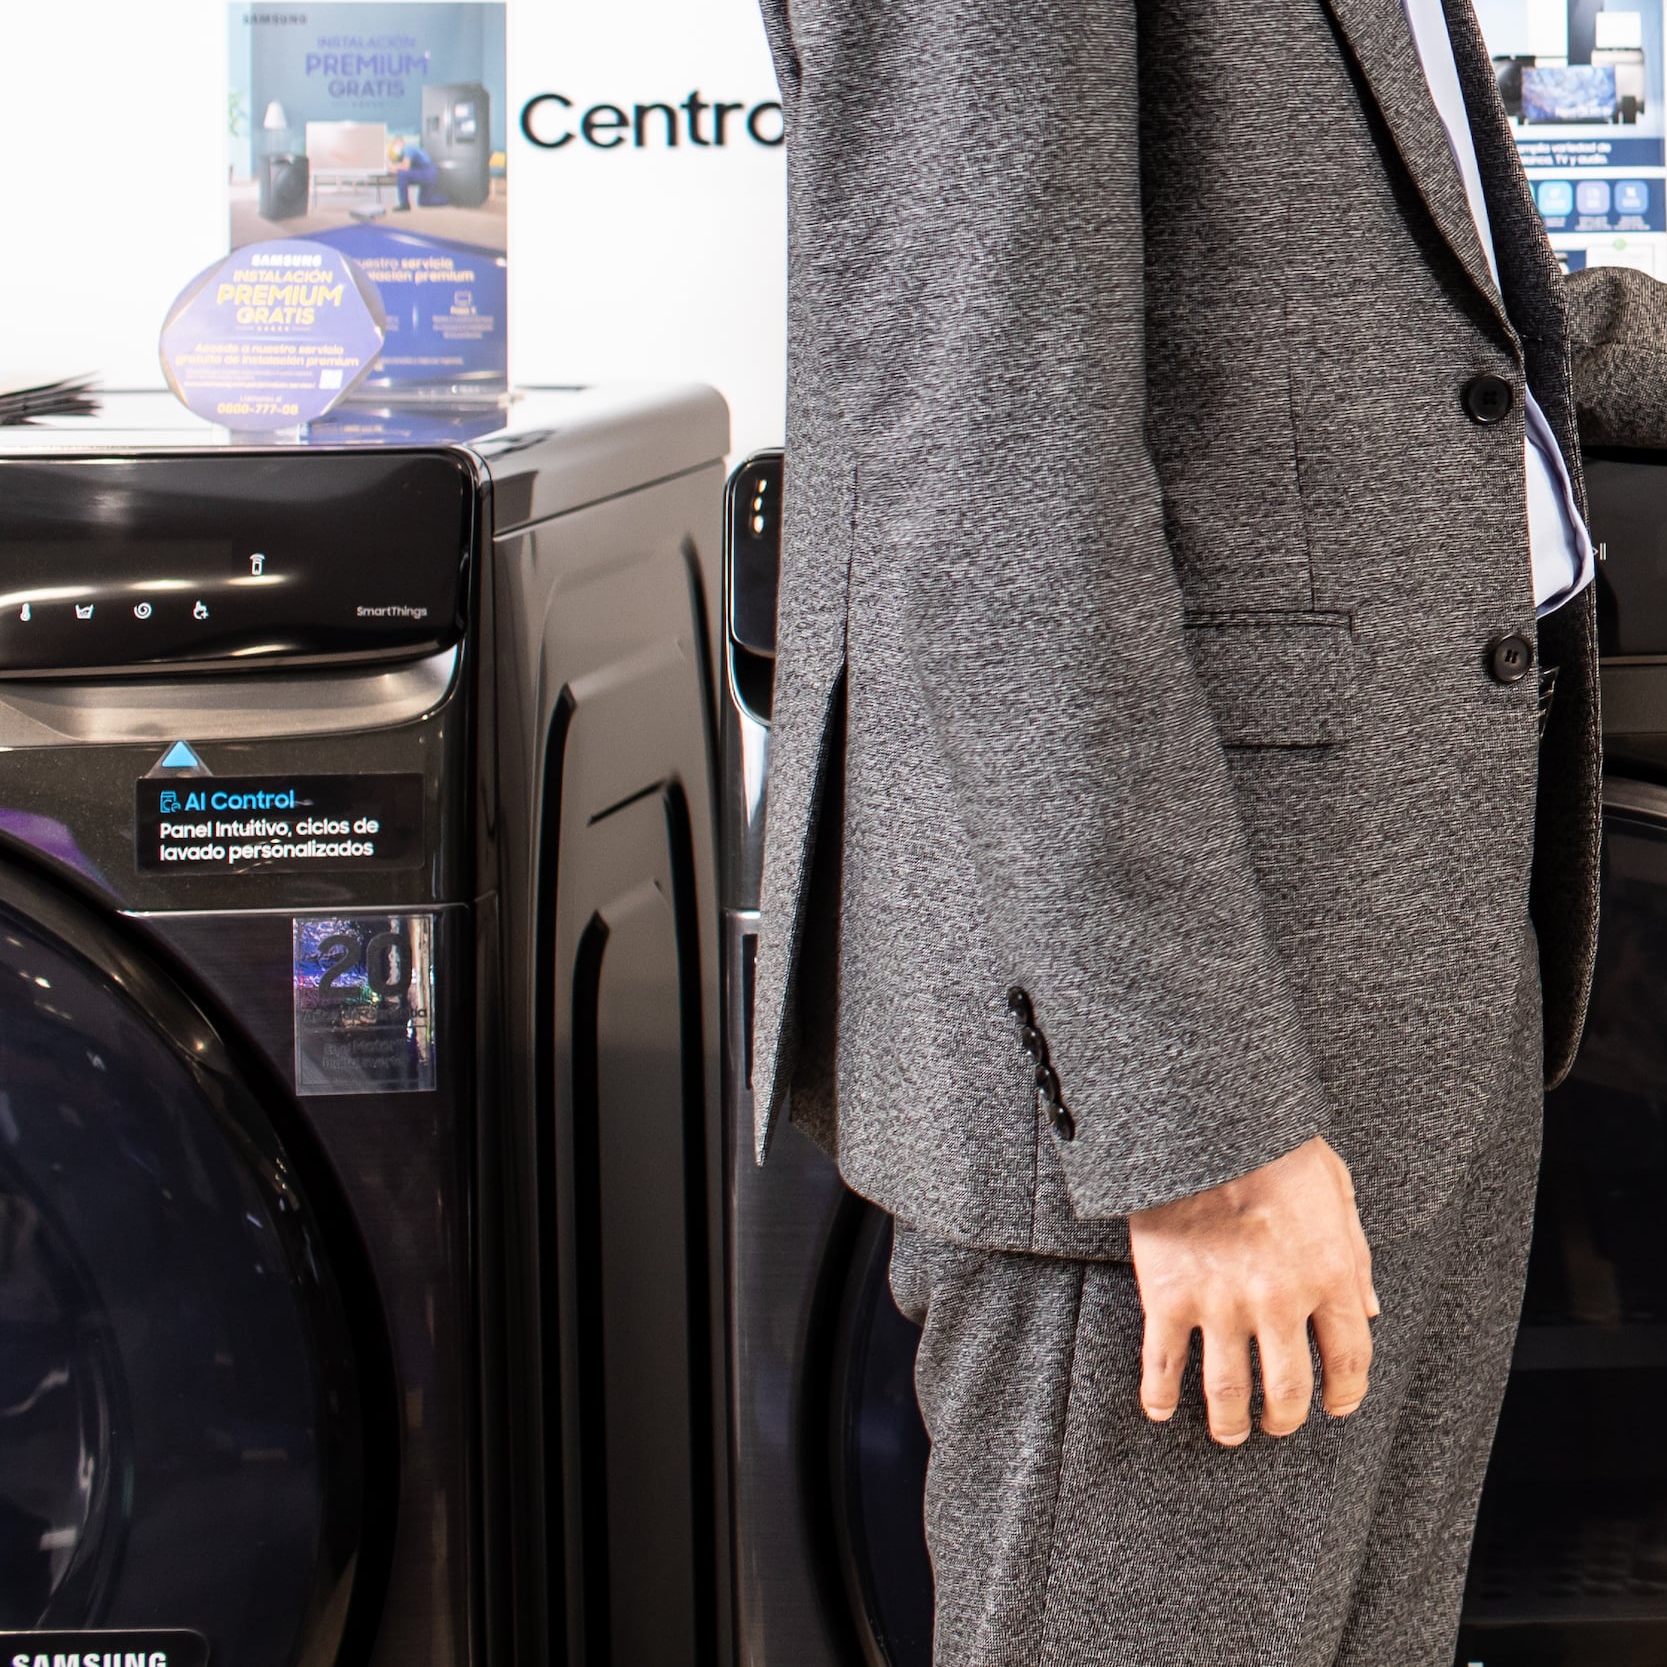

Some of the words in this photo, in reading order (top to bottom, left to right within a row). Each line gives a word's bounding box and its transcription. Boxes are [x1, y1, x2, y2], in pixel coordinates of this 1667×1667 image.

[242, 13, 308, 25] SAMSUNG
[306, 53, 429, 76] PREMIUM
[328, 79, 407, 98] GRATIS
[519, 90, 785, 149] Centro
[251, 254, 323, 267] SAMSUNG
[233, 269, 334, 283] INSTALACIÓN
[217, 284, 344, 306] PREMIUM
[236, 307, 316, 325] GRATIS
[356, 605, 428, 618] SmartThings
[184, 791, 206, 812] AI
[211, 789, 295, 811] Control
[160, 822, 212, 839] Panel
[215, 819, 293, 838] Intuitivo,
[296, 819, 350, 836] ciclos
[353, 817, 380, 835] de
[160, 844, 226, 862] lavado
[228, 841, 375, 864] personalizados
[316, 932, 413, 1000] 20
[11, 1652, 169, 1667] SAMSUNG
